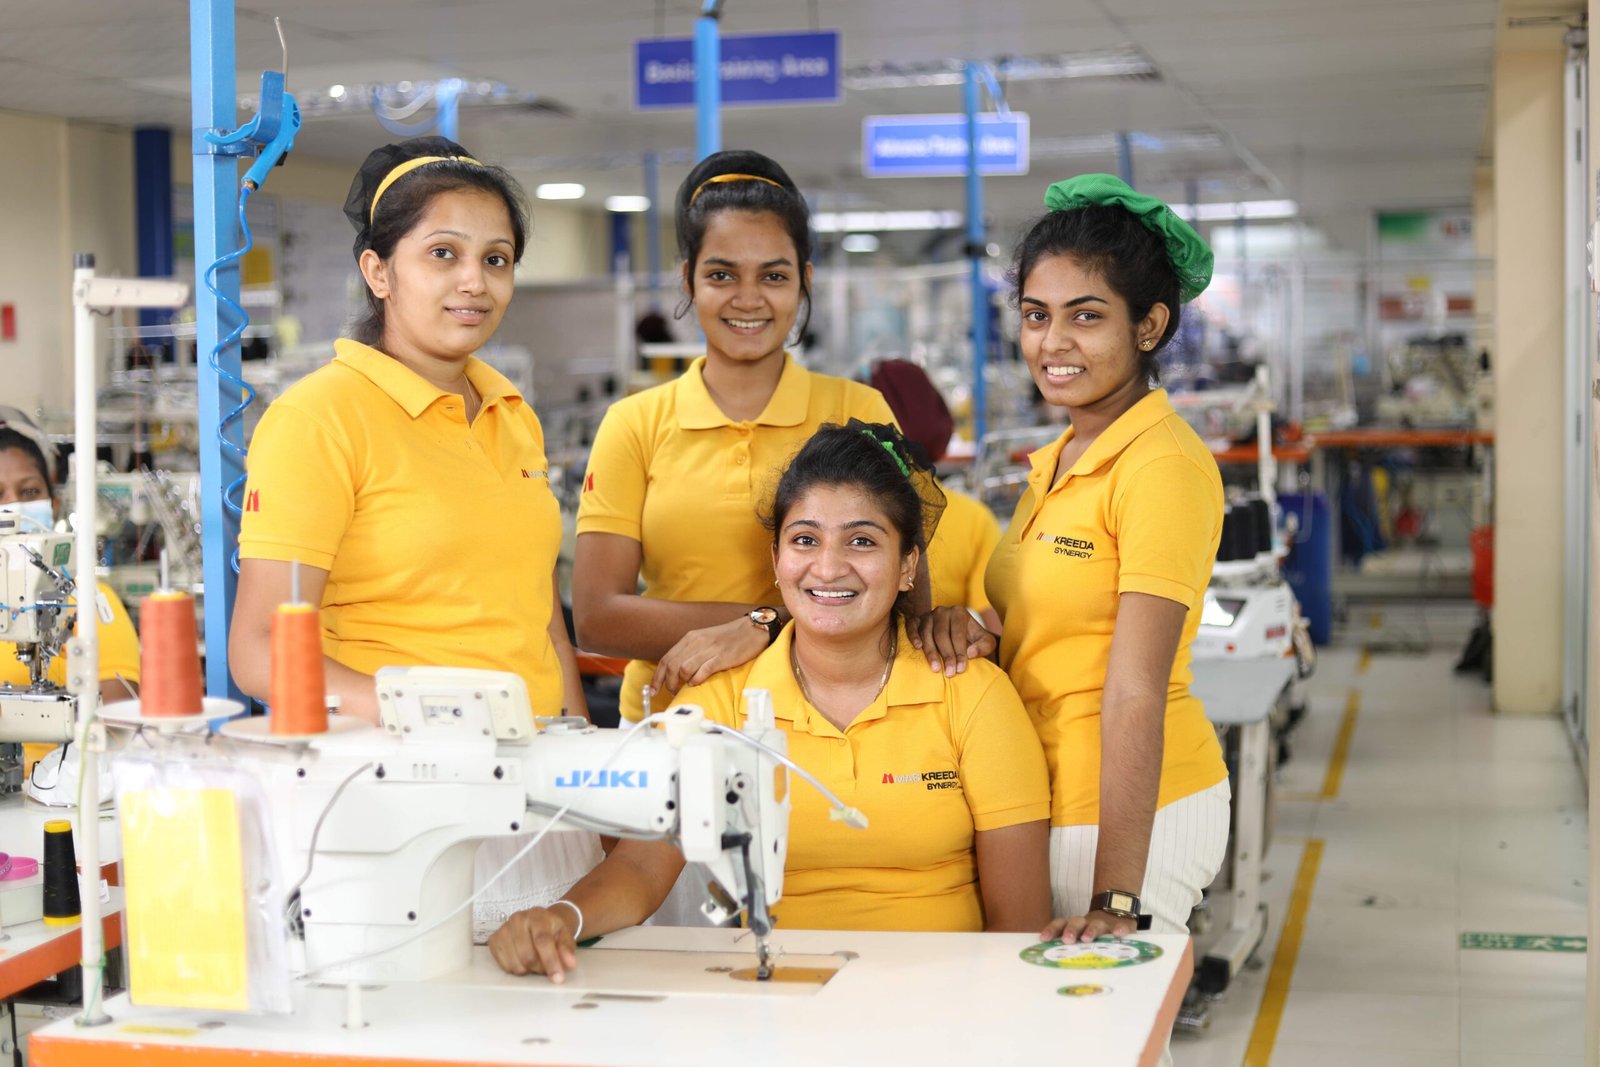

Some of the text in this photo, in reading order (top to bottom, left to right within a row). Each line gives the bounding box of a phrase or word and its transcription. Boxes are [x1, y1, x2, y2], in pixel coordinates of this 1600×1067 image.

[719, 57, 779, 83] aining
[1054, 536, 1094, 550] KREEDA
[1054, 547, 1092, 559] SYNERGY
[556, 770, 647, 787] JUKI
